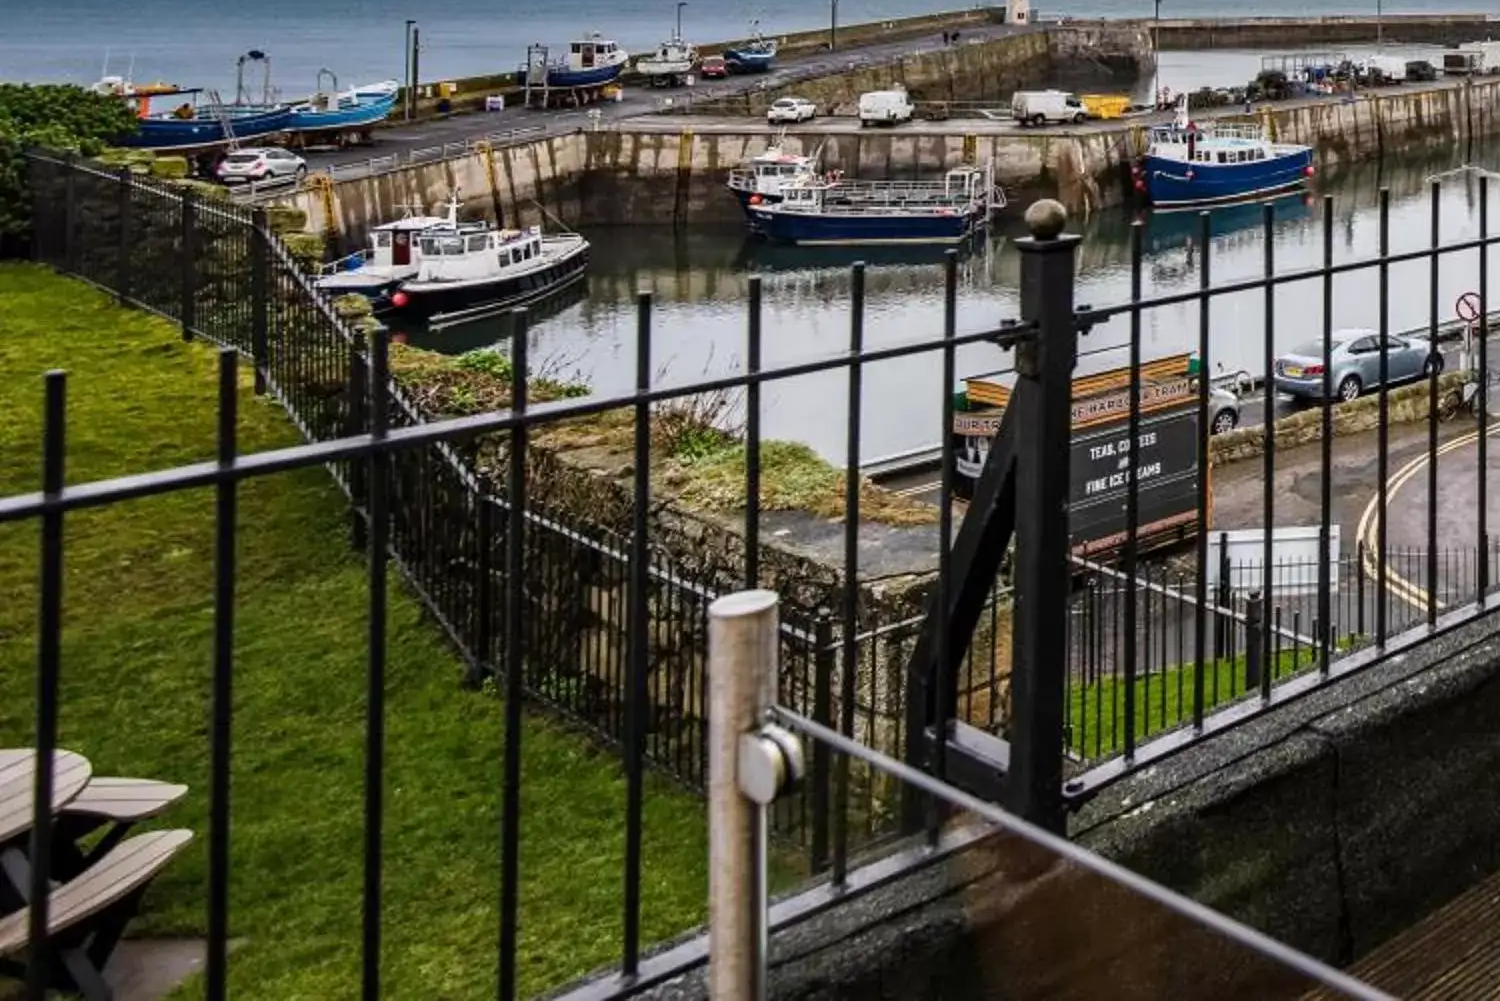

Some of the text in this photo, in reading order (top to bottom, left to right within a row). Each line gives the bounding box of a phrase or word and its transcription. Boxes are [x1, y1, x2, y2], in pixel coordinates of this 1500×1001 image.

[1090, 432, 1157, 460] TEAS, COEES
[1109, 471, 1124, 488] ICE
[1125, 462, 1161, 481] CEAMS
